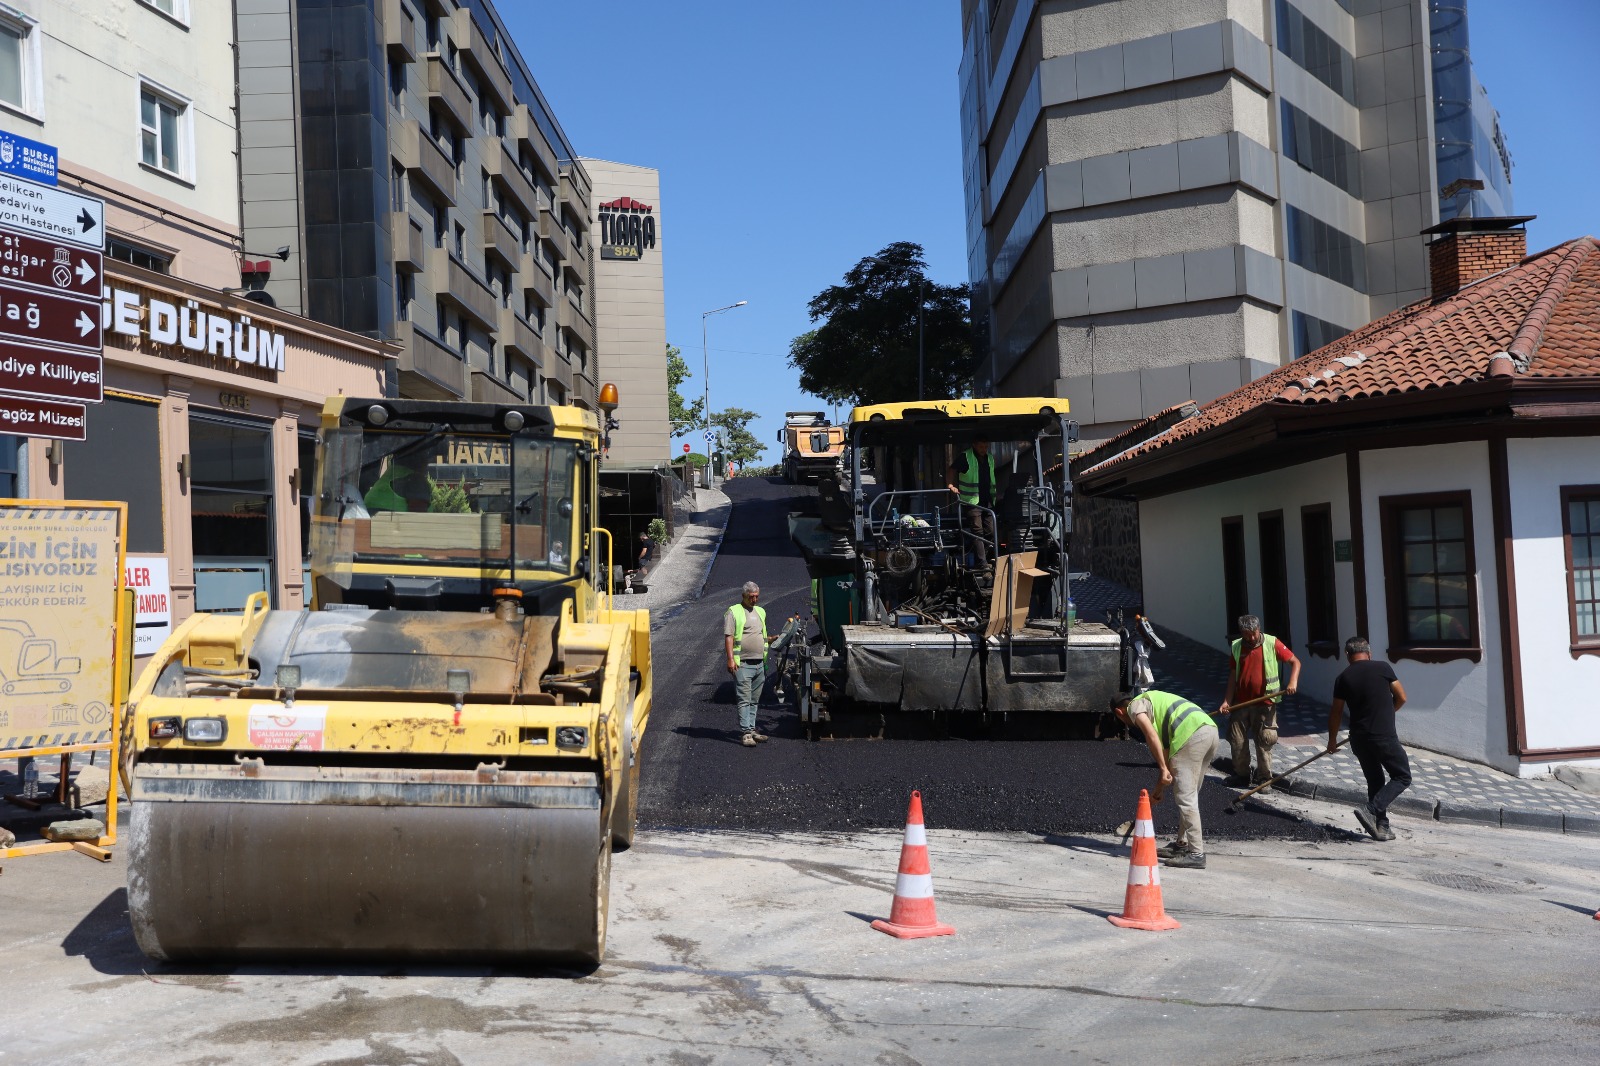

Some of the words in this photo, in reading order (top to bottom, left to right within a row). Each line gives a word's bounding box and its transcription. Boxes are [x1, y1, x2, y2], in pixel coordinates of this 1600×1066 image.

[23, 147, 55, 163] BURSA
[23, 163, 55, 176] BELEDİYESİ
[33, 204, 46, 214] ve
[22, 214, 76, 236] Hastanesi
[598, 213, 656, 259] TIARA
[614, 247, 638, 256] SPA
[2, 264, 24, 277] esi
[150, 299, 285, 371] DÜRÜM
[41, 362, 100, 384] Külliyesi
[39, 410, 84, 427] Müzesi
[45, 536, 98, 562] İÇİN
[60, 583, 84, 595] İÇİN
[44, 595, 87, 606] EDERİZ
